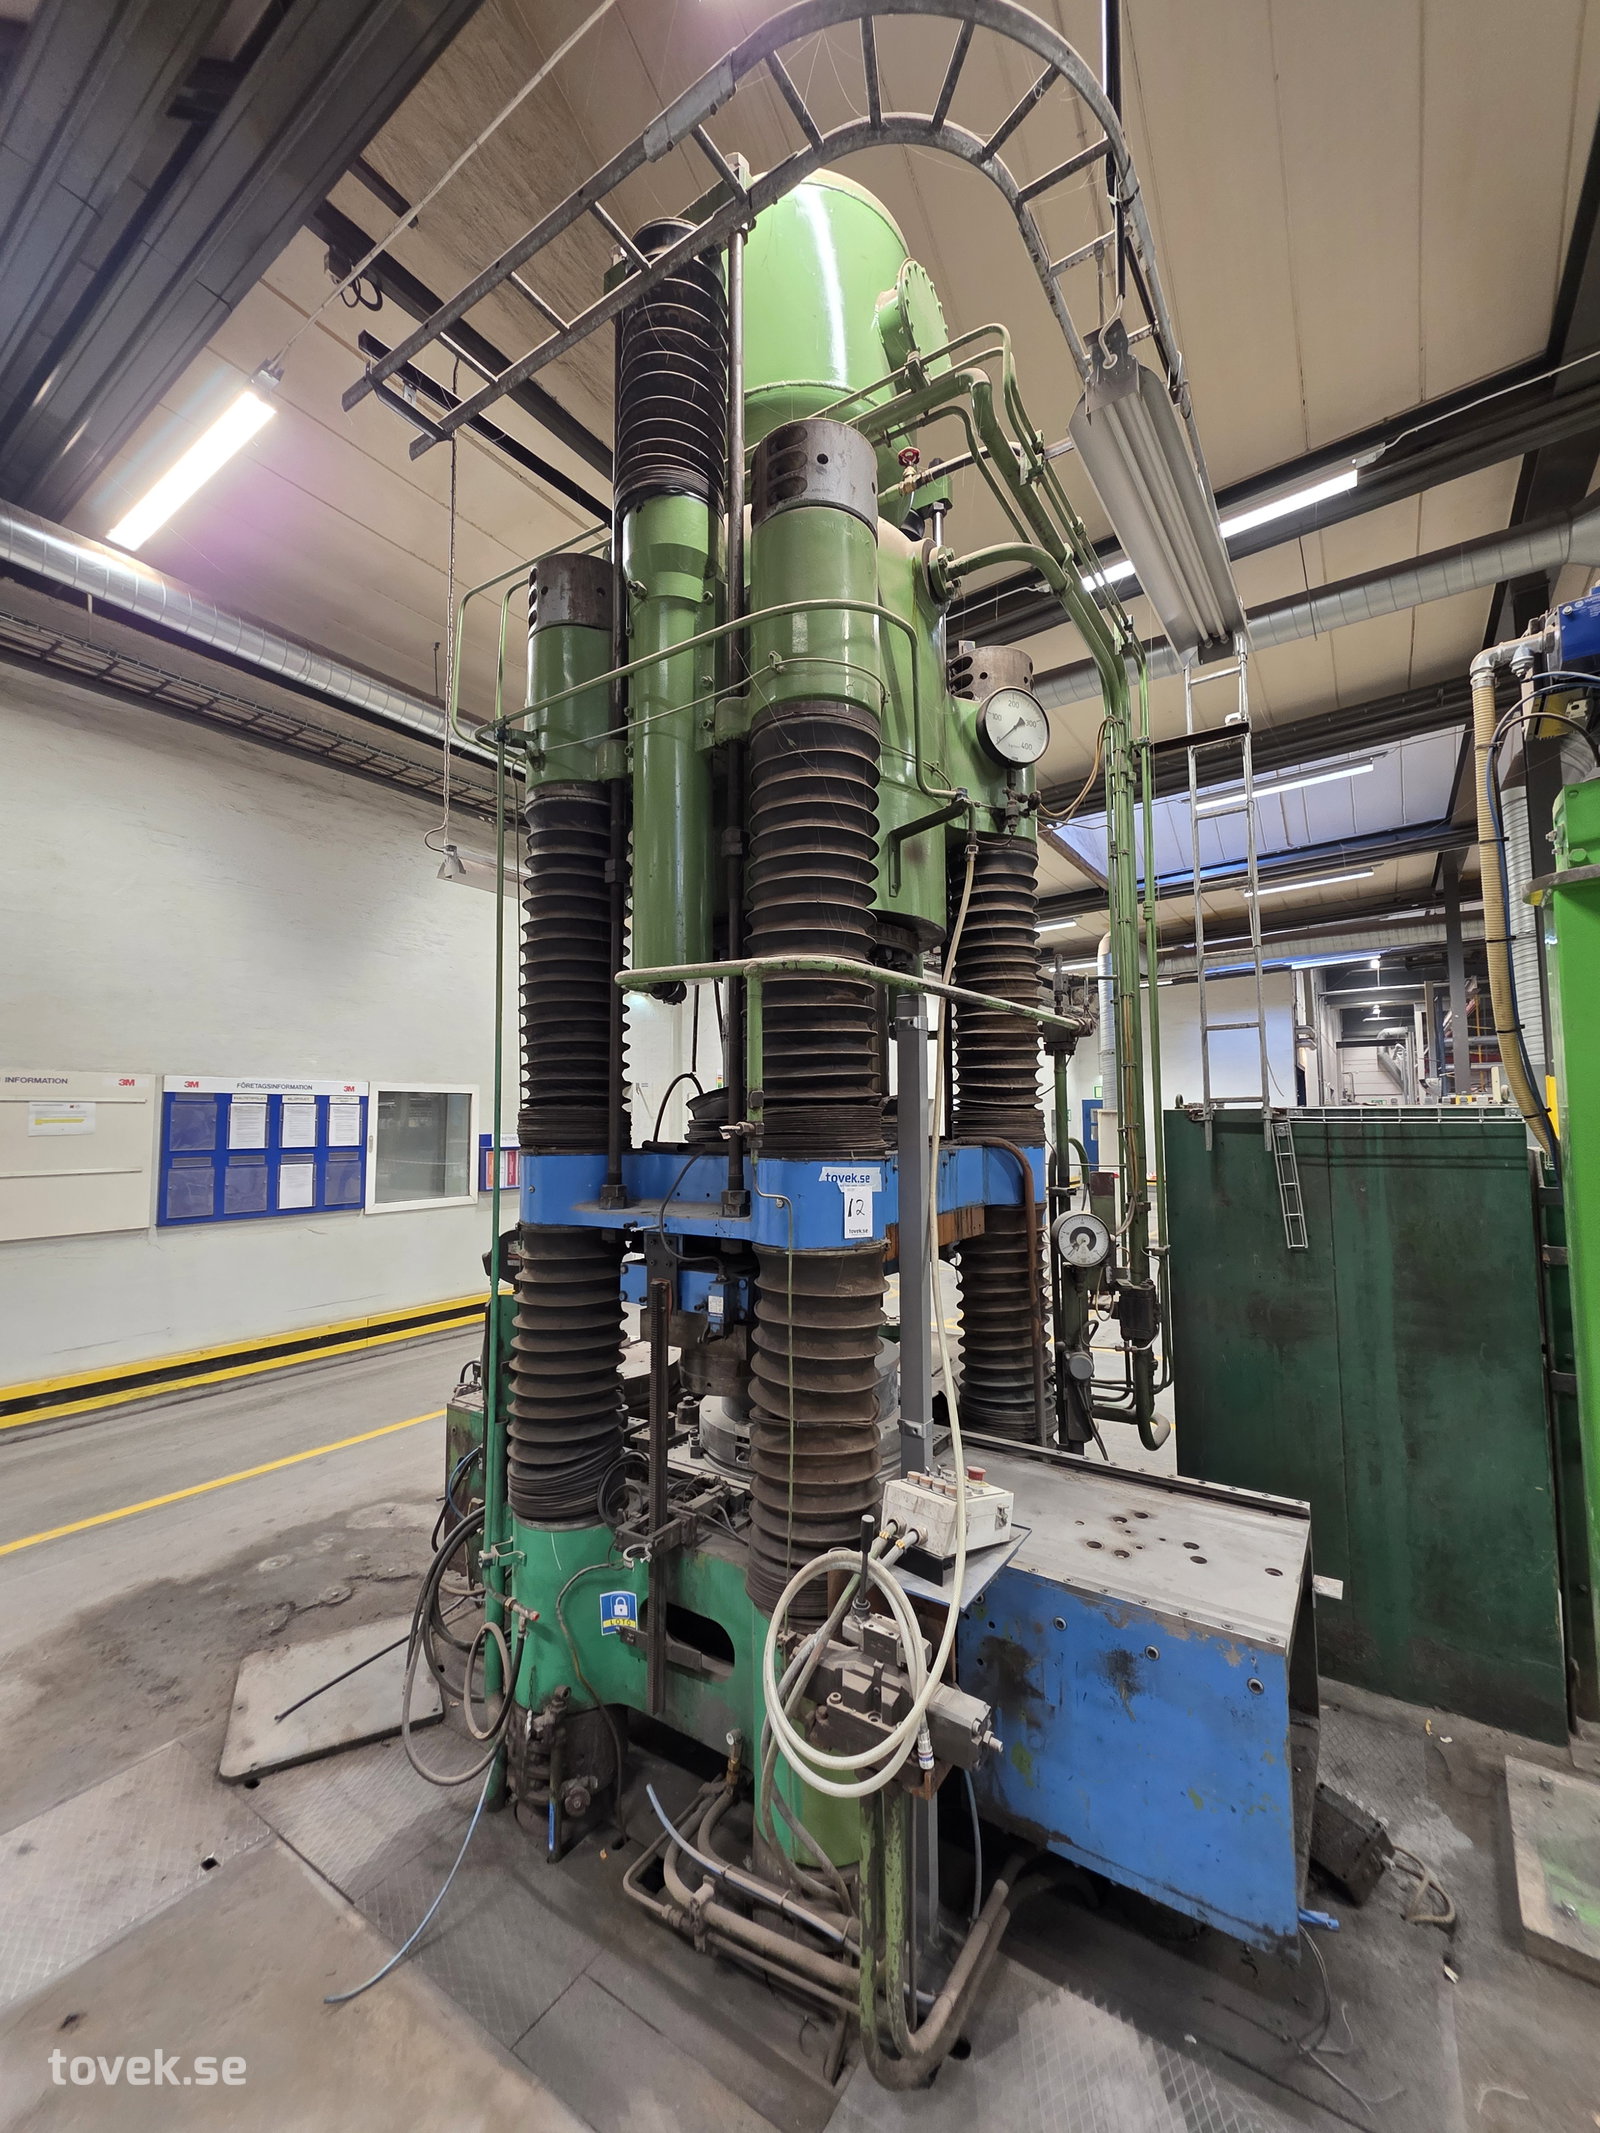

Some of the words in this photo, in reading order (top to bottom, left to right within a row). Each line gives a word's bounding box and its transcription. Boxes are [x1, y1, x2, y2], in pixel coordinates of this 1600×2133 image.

[1008, 700, 1019, 709] 200
[992, 713, 1002, 721] 100
[1025, 720, 1036, 728] 300
[1021, 743, 1032, 751] 400
[4, 1076, 69, 1084] INFORMATION
[118, 1079, 135, 1087] 3M
[236, 1082, 313, 1090] FÖRETAGSINFORMATION
[825, 1172, 870, 1183] tovek.se
[847, 1198, 865, 1217] 12
